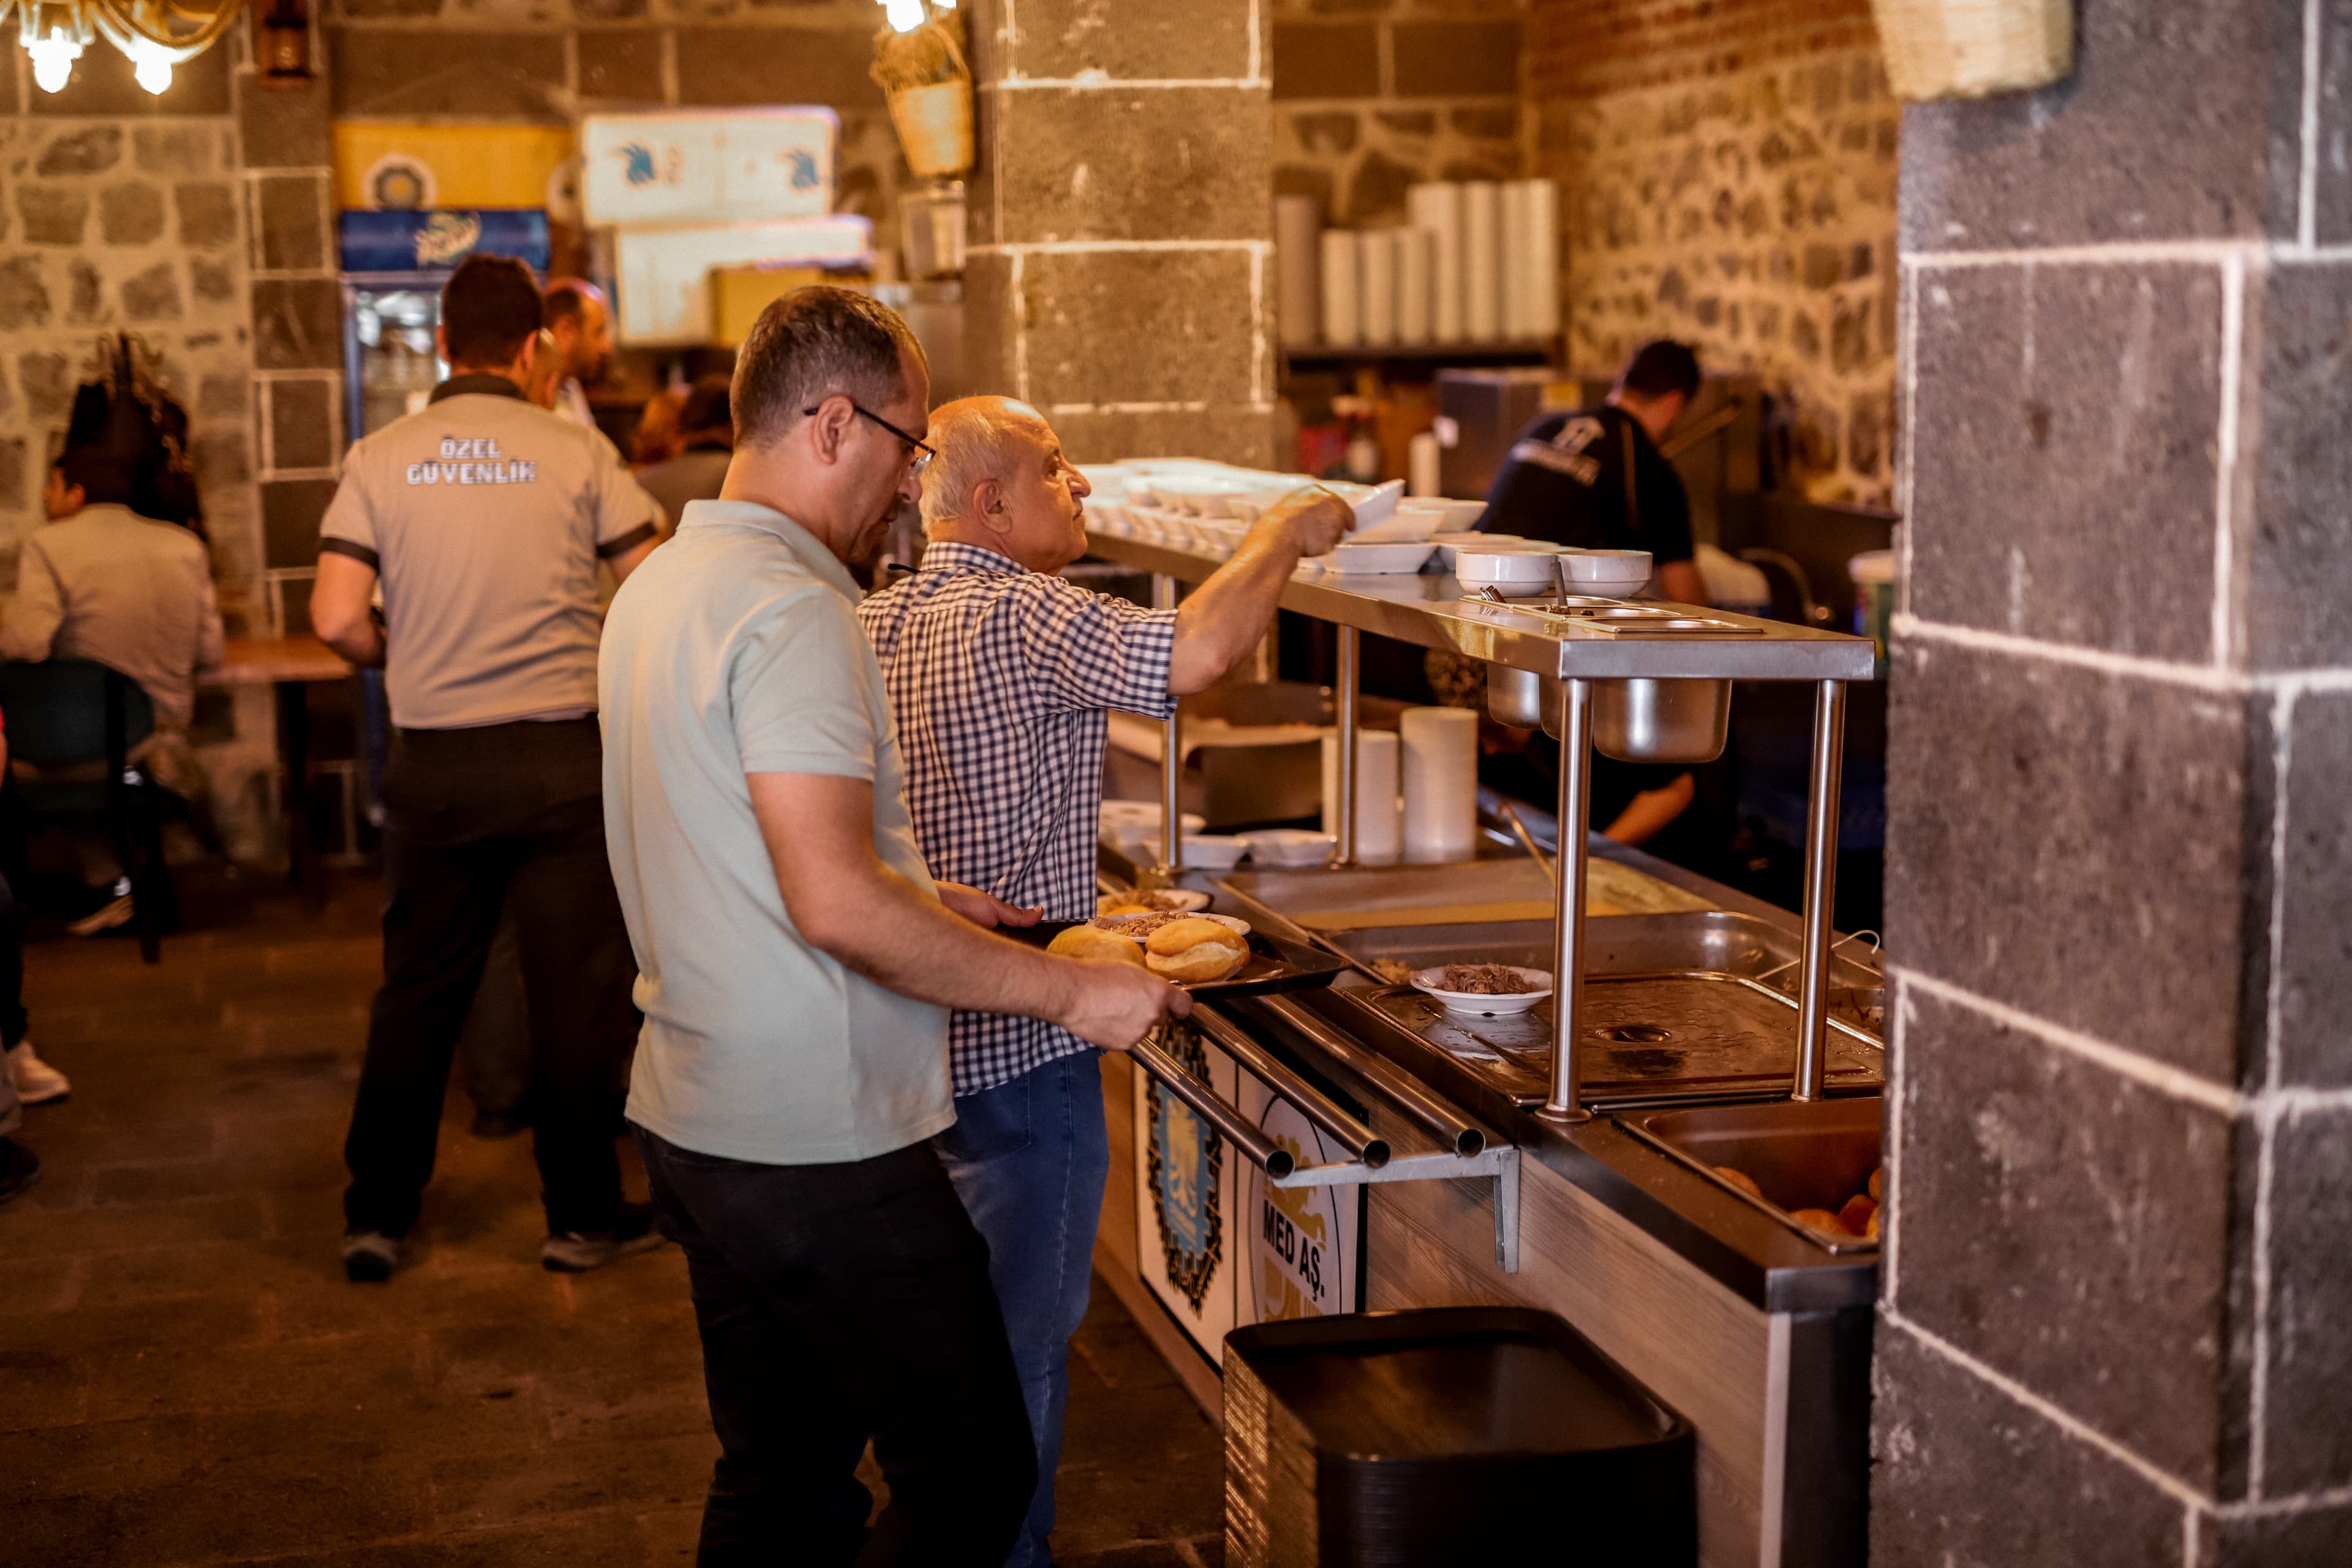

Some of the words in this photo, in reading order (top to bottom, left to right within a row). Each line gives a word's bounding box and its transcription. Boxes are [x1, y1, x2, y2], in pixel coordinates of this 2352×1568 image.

[440, 435, 502, 459] ÖZEL
[407, 459, 537, 484] GÜVENLİK
[1264, 1199, 1295, 1265] MED
[1299, 1237, 1325, 1302] AŞ.
